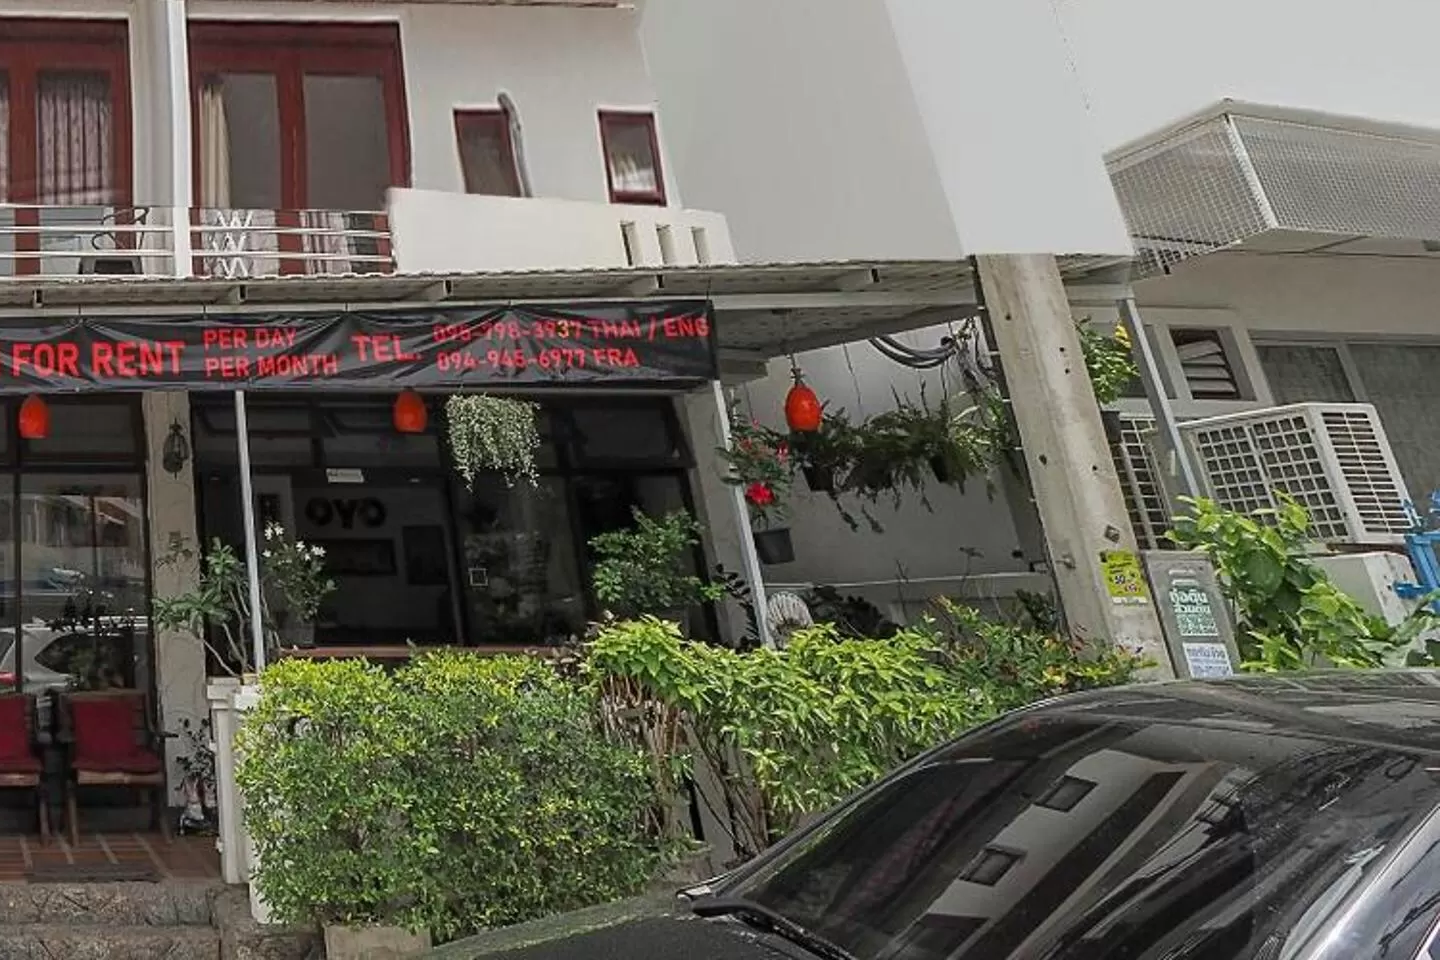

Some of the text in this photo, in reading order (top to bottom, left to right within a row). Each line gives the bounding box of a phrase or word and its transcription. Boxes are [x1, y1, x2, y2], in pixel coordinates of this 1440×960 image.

[203, 327, 297, 351] PER DAY
[590, 319, 641, 338] THAI
[663, 317, 708, 337] ENG
[12, 342, 80, 376] FOR
[92, 341, 185, 376] RENT
[352, 335, 422, 362] TEL.
[593, 348, 640, 368] FRA
[205, 353, 338, 377] PER MONTH
[305, 497, 387, 529] OYO
